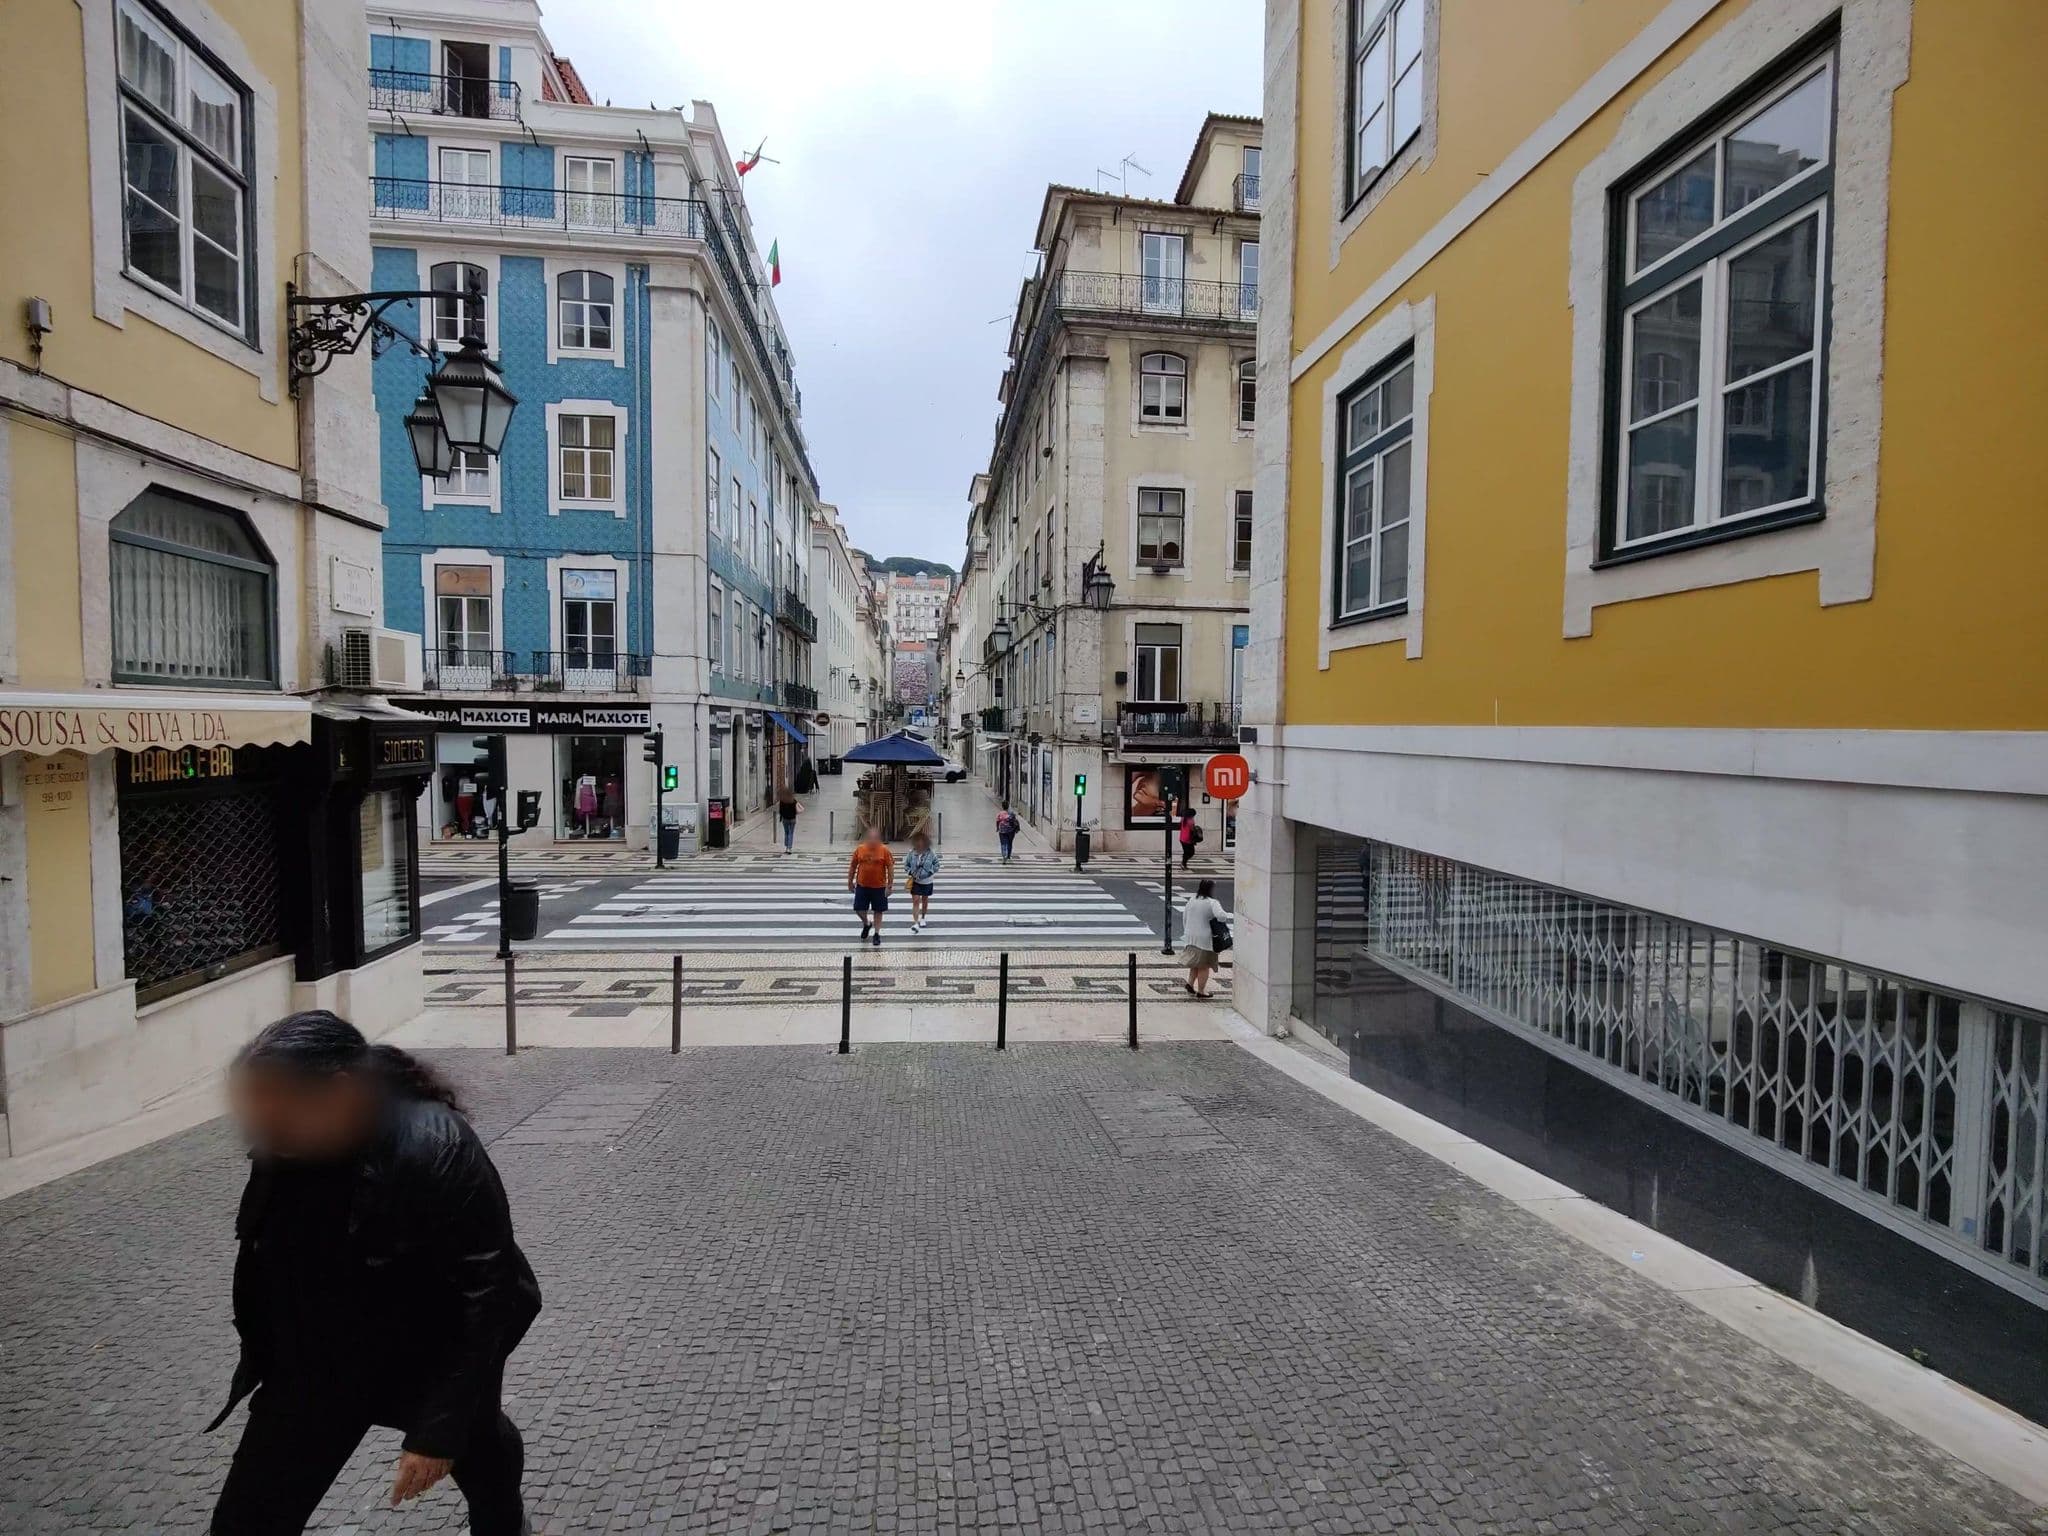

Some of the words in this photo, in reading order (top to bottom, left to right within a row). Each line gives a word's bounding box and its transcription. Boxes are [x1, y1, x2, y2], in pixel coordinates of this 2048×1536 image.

[464, 711, 528, 723] MAXLOTE
[538, 712, 582, 724] MARIA
[586, 712, 648, 724] MAXLOTE
[0, 710, 87, 747] SOUSA
[96, 712, 119, 744] &
[127, 711, 183, 744] SILVA
